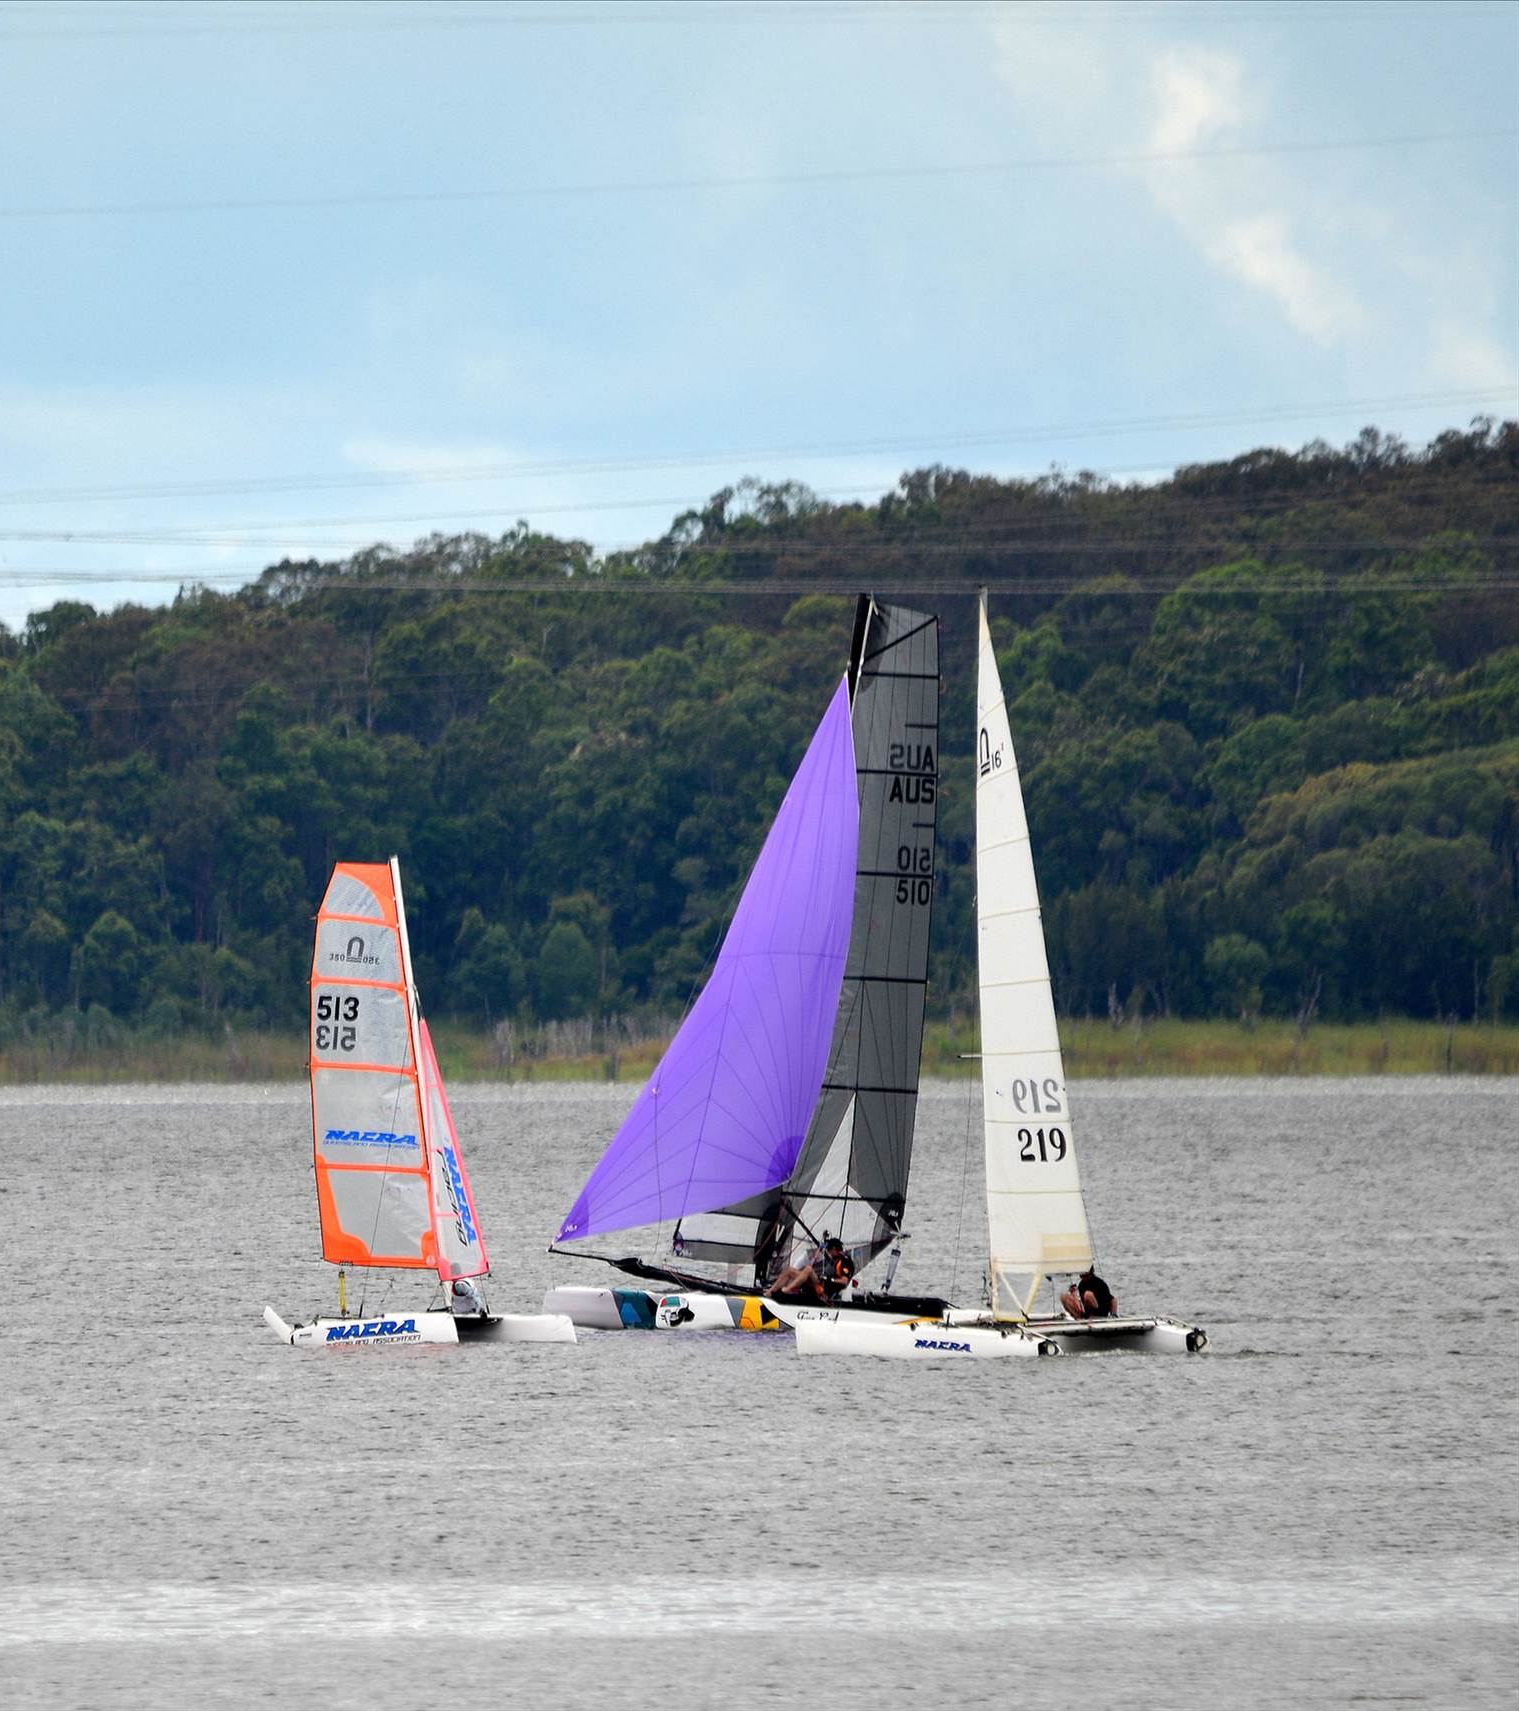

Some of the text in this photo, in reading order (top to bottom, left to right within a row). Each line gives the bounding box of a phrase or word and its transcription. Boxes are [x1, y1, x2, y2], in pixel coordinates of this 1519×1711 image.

[991, 750, 1002, 771] 16
[889, 776, 935, 805] AUS
[896, 879, 931, 907] 510
[317, 996, 360, 1022] 513
[325, 1129, 417, 1146] NACRA
[1017, 1127, 1067, 1163] 219
[325, 1319, 420, 1342] NACRA
[914, 1339, 972, 1353] NACRA
